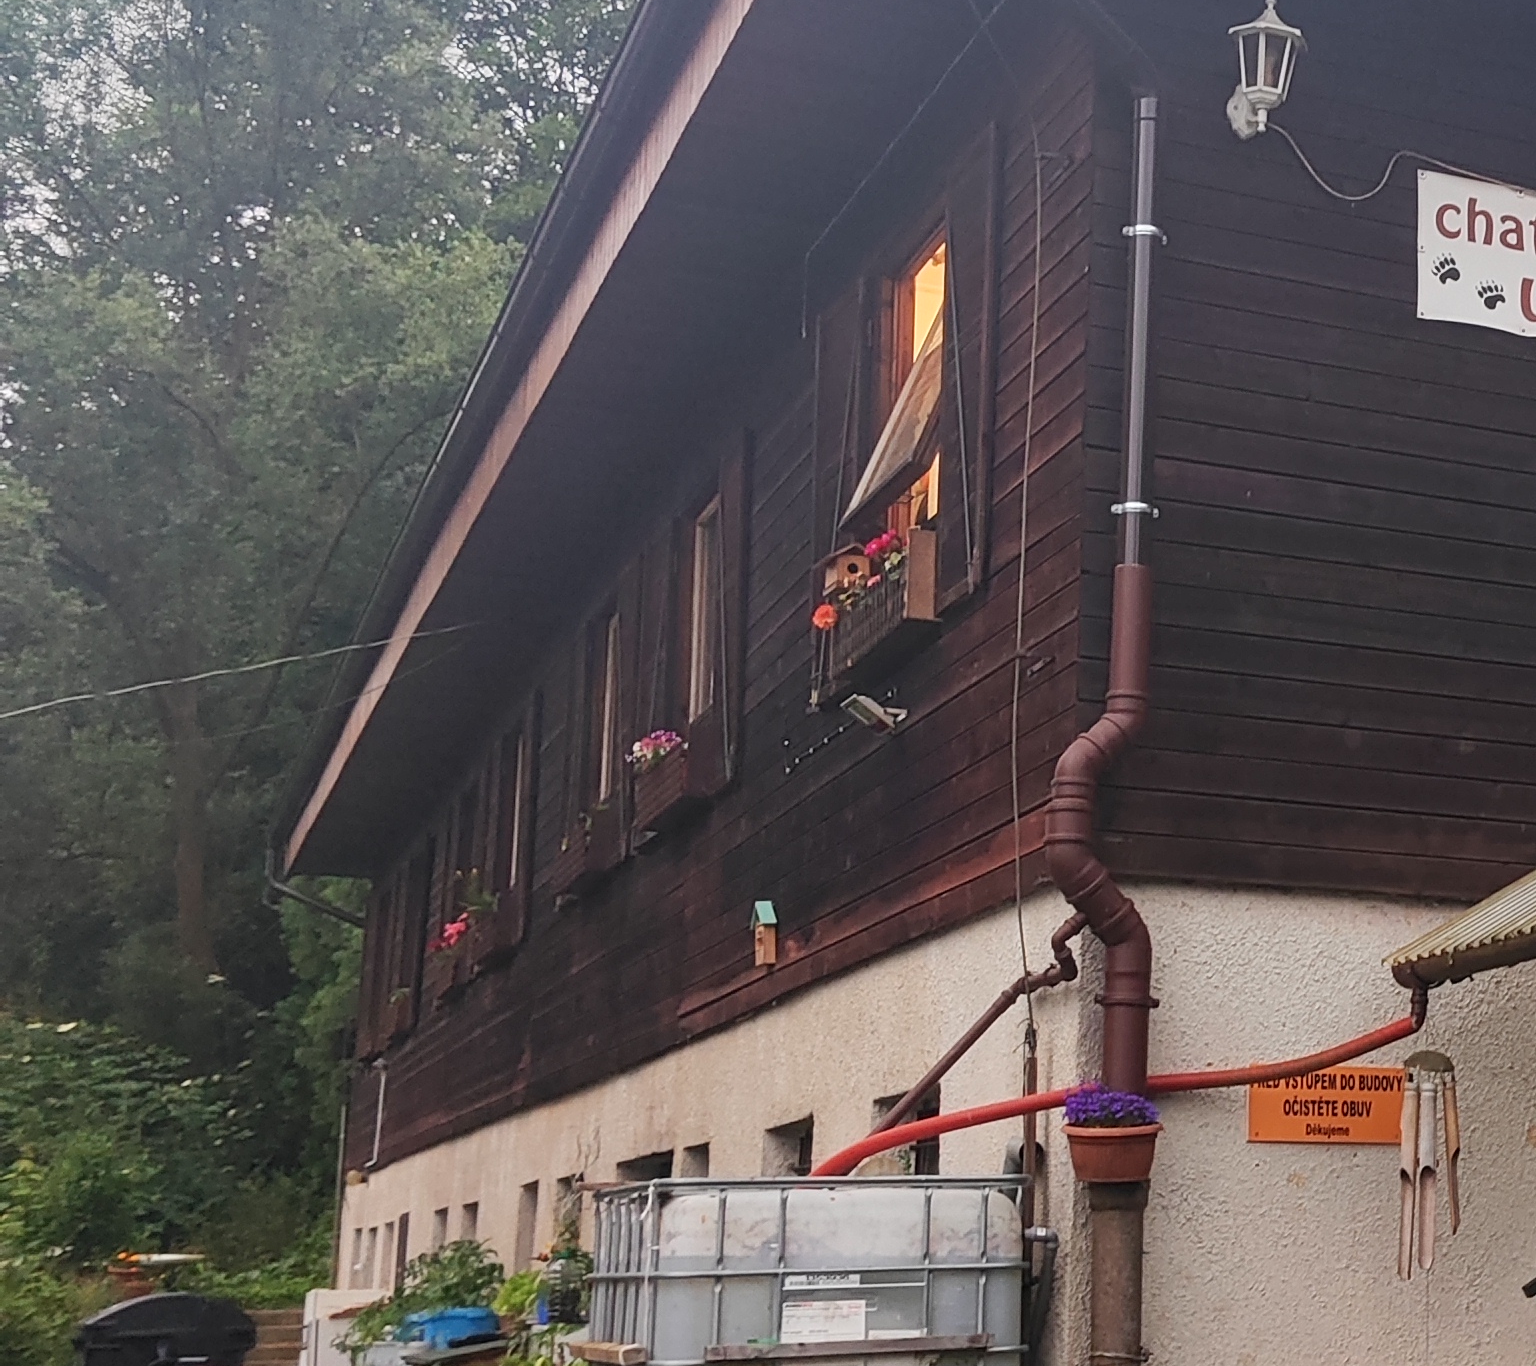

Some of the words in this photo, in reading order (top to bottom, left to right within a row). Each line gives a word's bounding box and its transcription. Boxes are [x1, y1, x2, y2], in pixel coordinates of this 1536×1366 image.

[1340, 1074, 1356, 1090] DO
[1358, 1075, 1403, 1092] BUDOVY
[1341, 1100, 1373, 1117] OBUV
